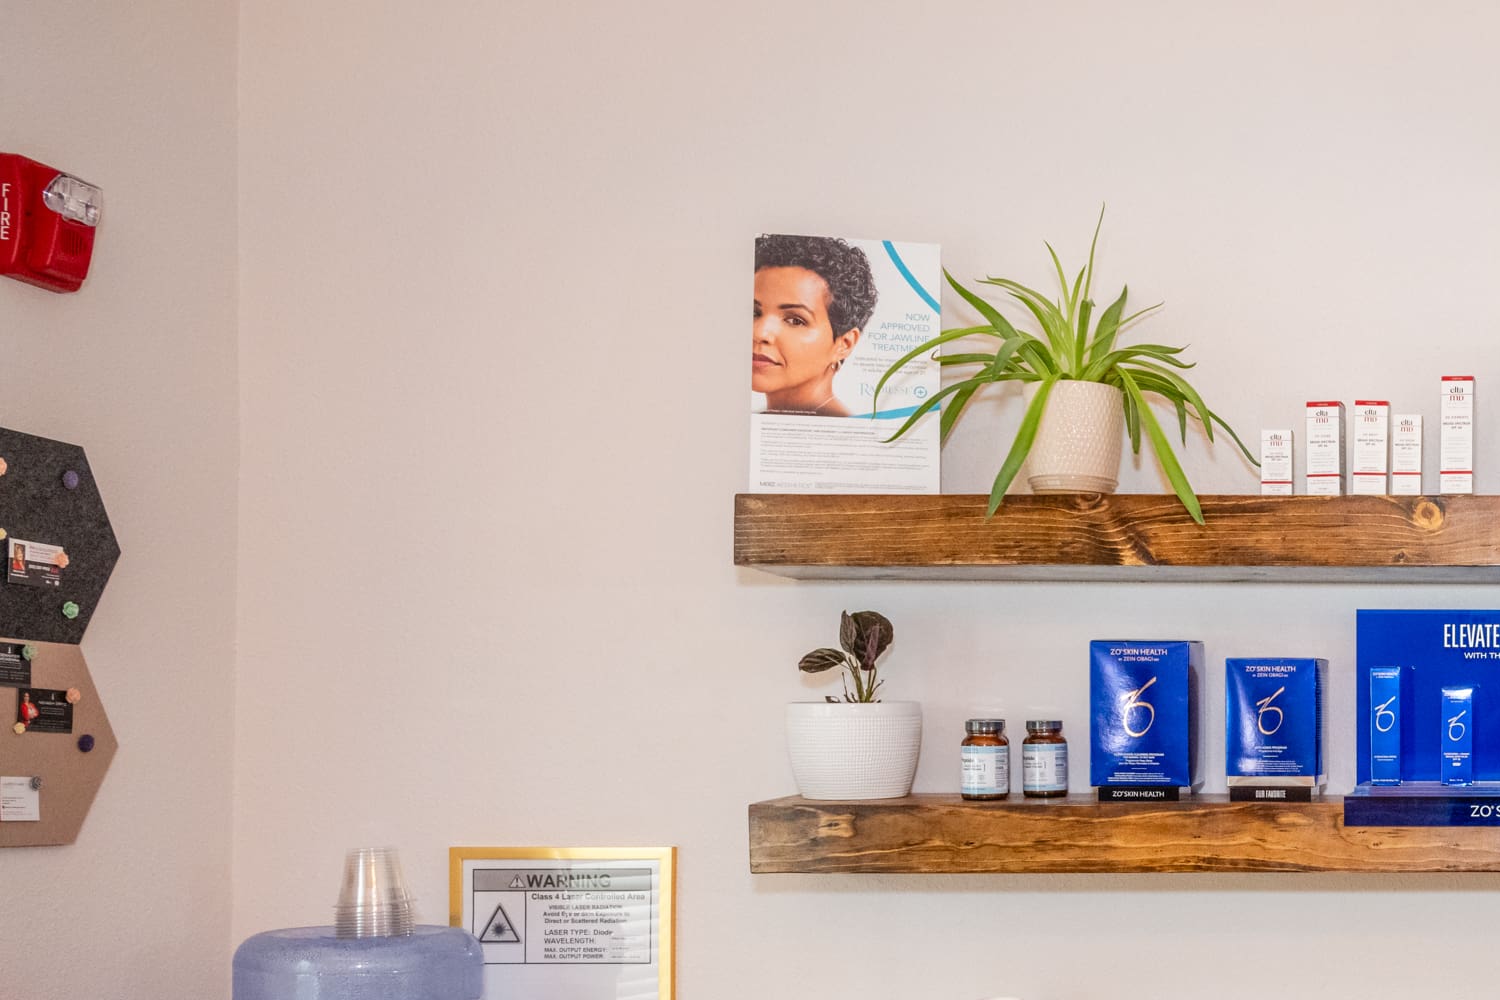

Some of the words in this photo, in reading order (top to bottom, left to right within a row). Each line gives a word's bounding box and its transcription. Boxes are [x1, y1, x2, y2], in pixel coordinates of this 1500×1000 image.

[0, 183, 11, 240] FIRE
[906, 313, 930, 321] NOW
[881, 323, 930, 332] APPROVED
[868, 332, 887, 341] FOR
[891, 333, 930, 343] JAWLINE
[1443, 624, 1500, 649] ELEVATE
[1464, 652, 1487, 660] WITH
[1124, 790, 1139, 798] SKIN
[1140, 790, 1165, 798] HEALTH
[527, 874, 612, 888] WARNING
